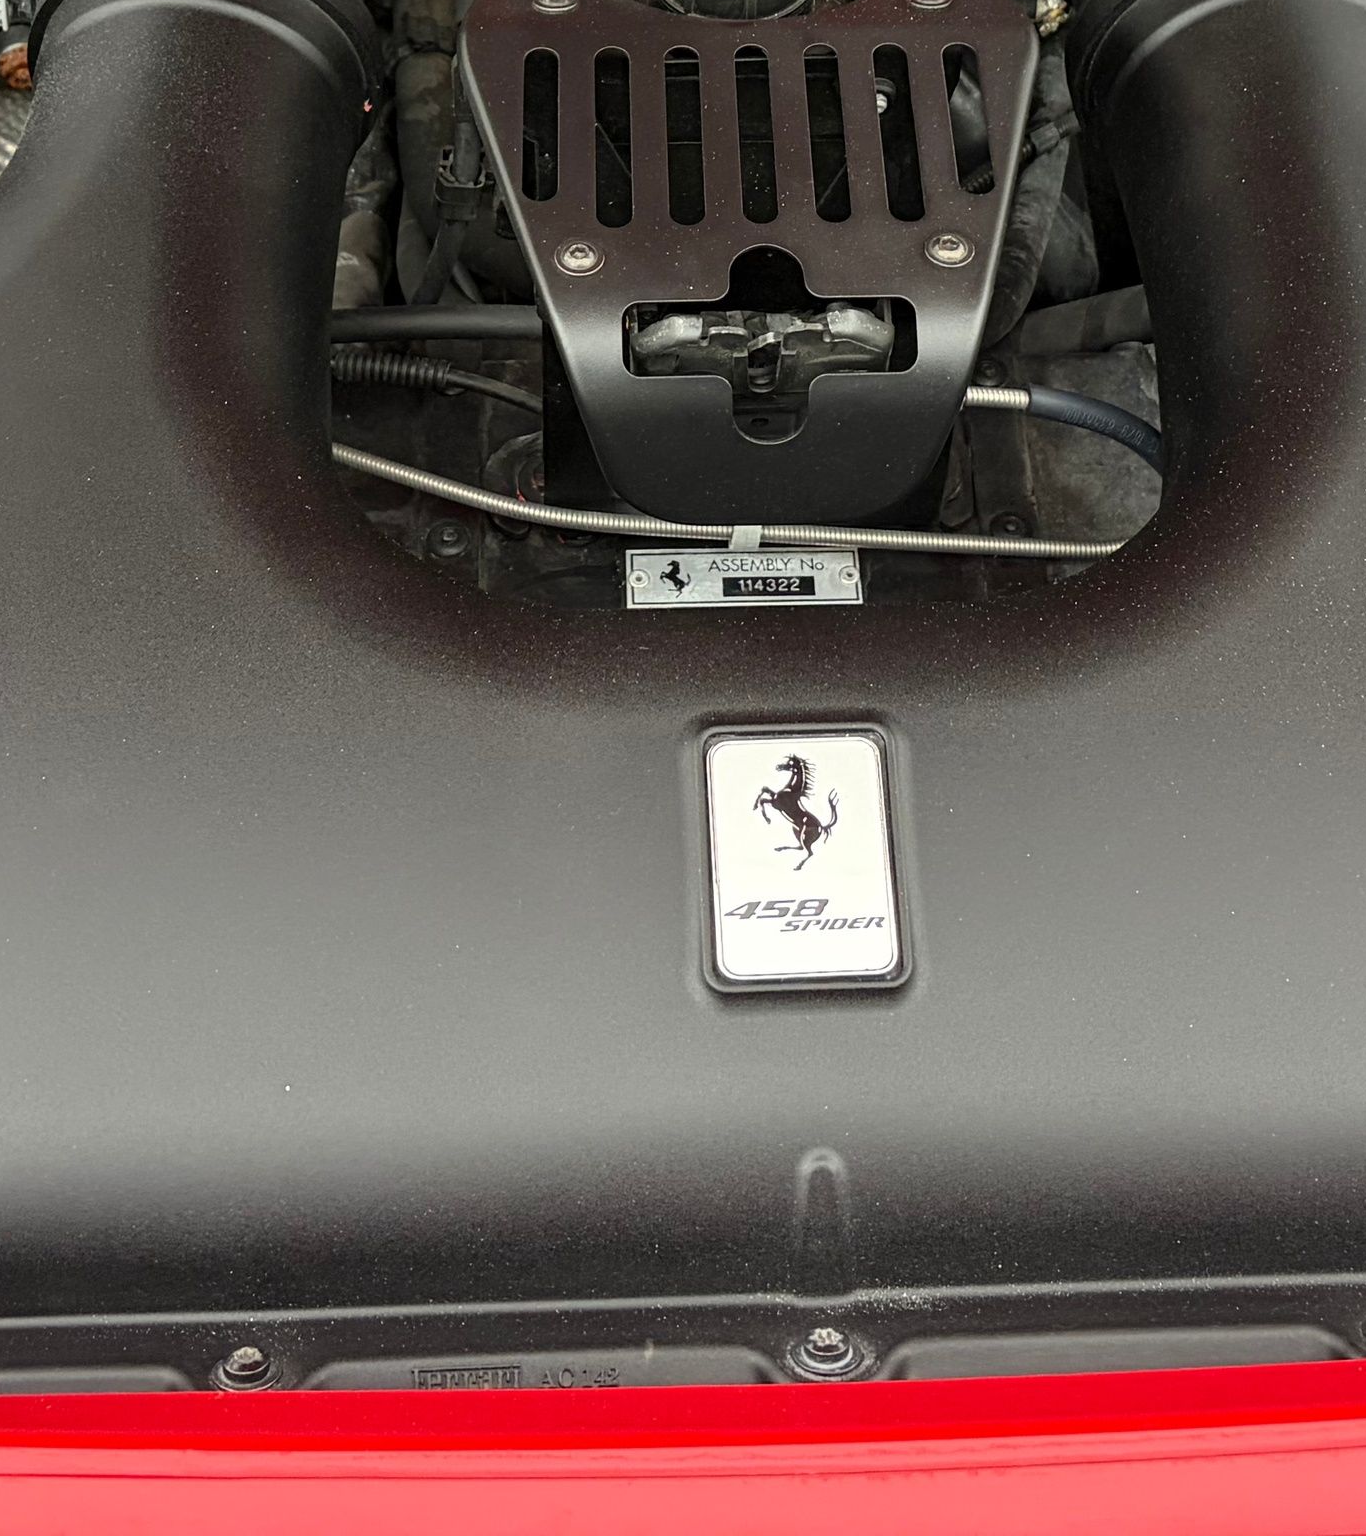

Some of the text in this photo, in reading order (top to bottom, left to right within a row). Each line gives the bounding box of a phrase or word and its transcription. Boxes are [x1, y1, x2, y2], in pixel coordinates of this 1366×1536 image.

[708, 558, 791, 573] ASSEMBLY
[737, 578, 801, 593] 114322
[724, 899, 829, 920] 458
[780, 917, 885, 933] SPIDER
[412, 1365, 521, 1390] Ferrari
[539, 1369, 575, 1390] AC
